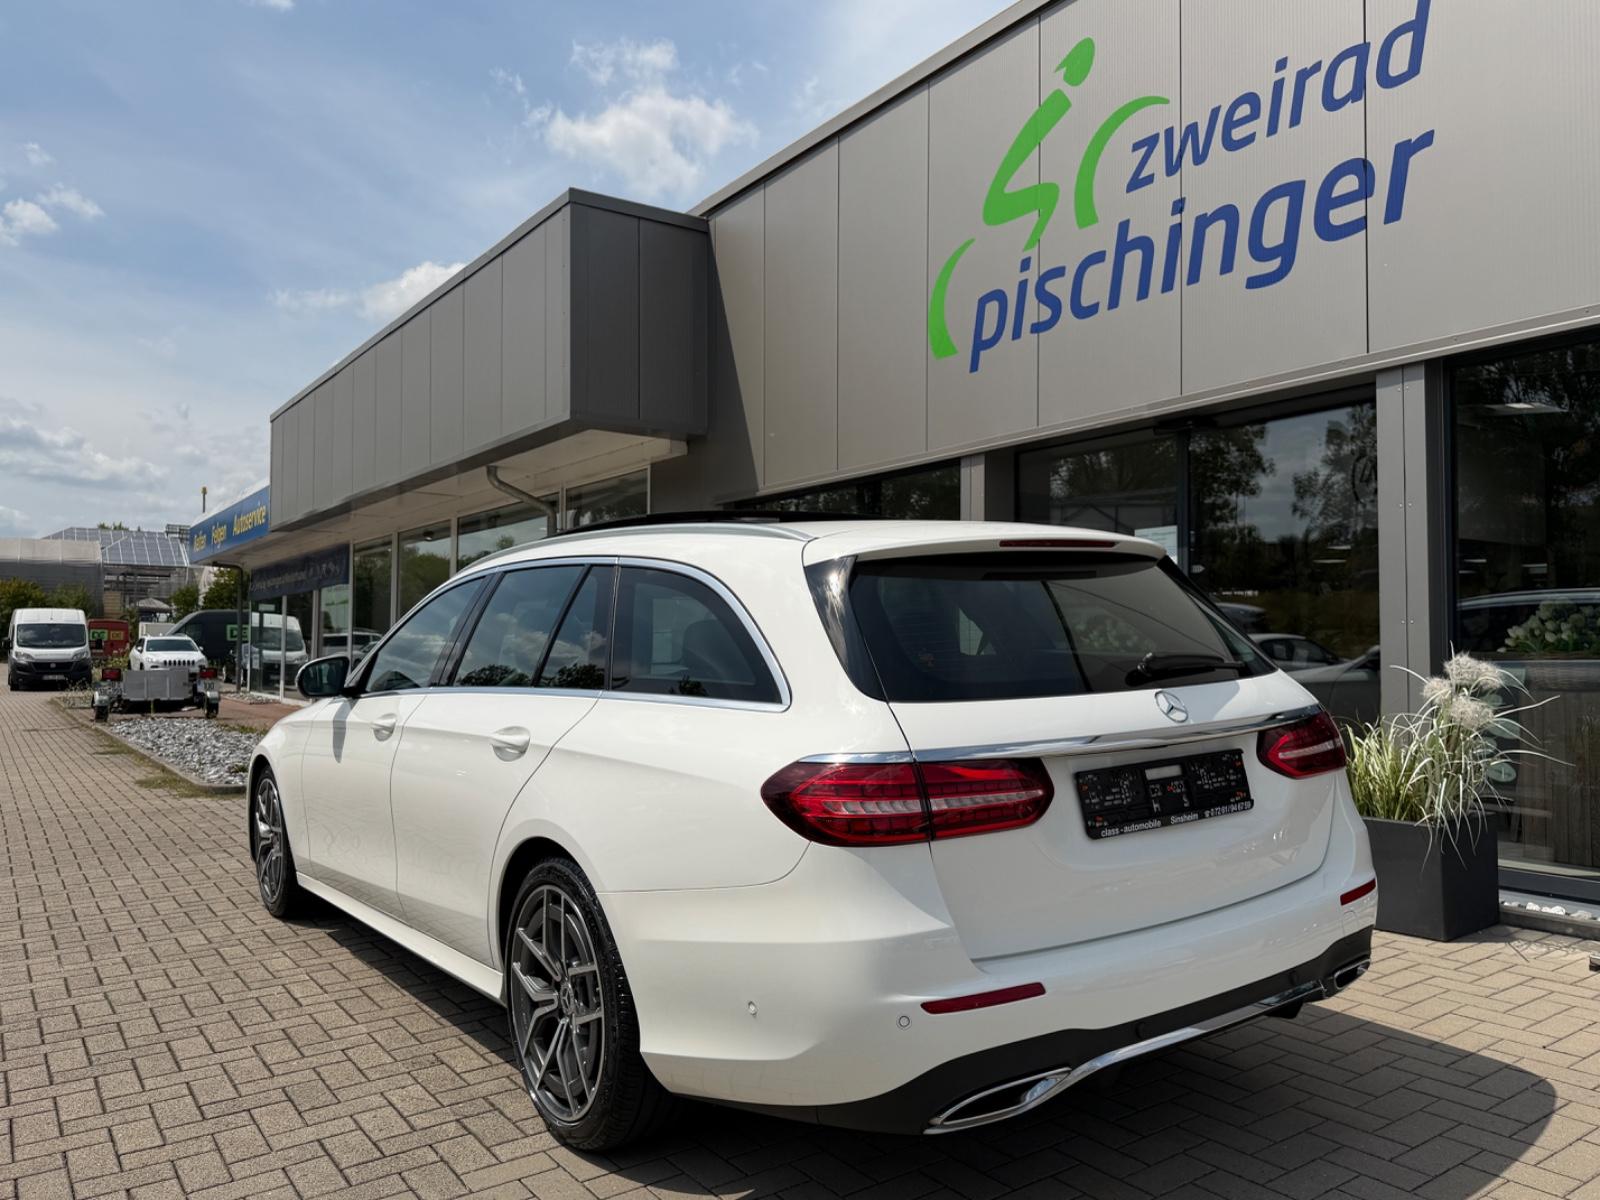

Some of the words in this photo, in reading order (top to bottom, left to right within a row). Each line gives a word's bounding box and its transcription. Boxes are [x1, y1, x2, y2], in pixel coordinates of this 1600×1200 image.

[1126, 0, 1431, 194] zweirad
[969, 128, 1435, 374] pischinger
[232, 501, 267, 537] Autoservice
[1170, 811, 1199, 825] Sinsheim
